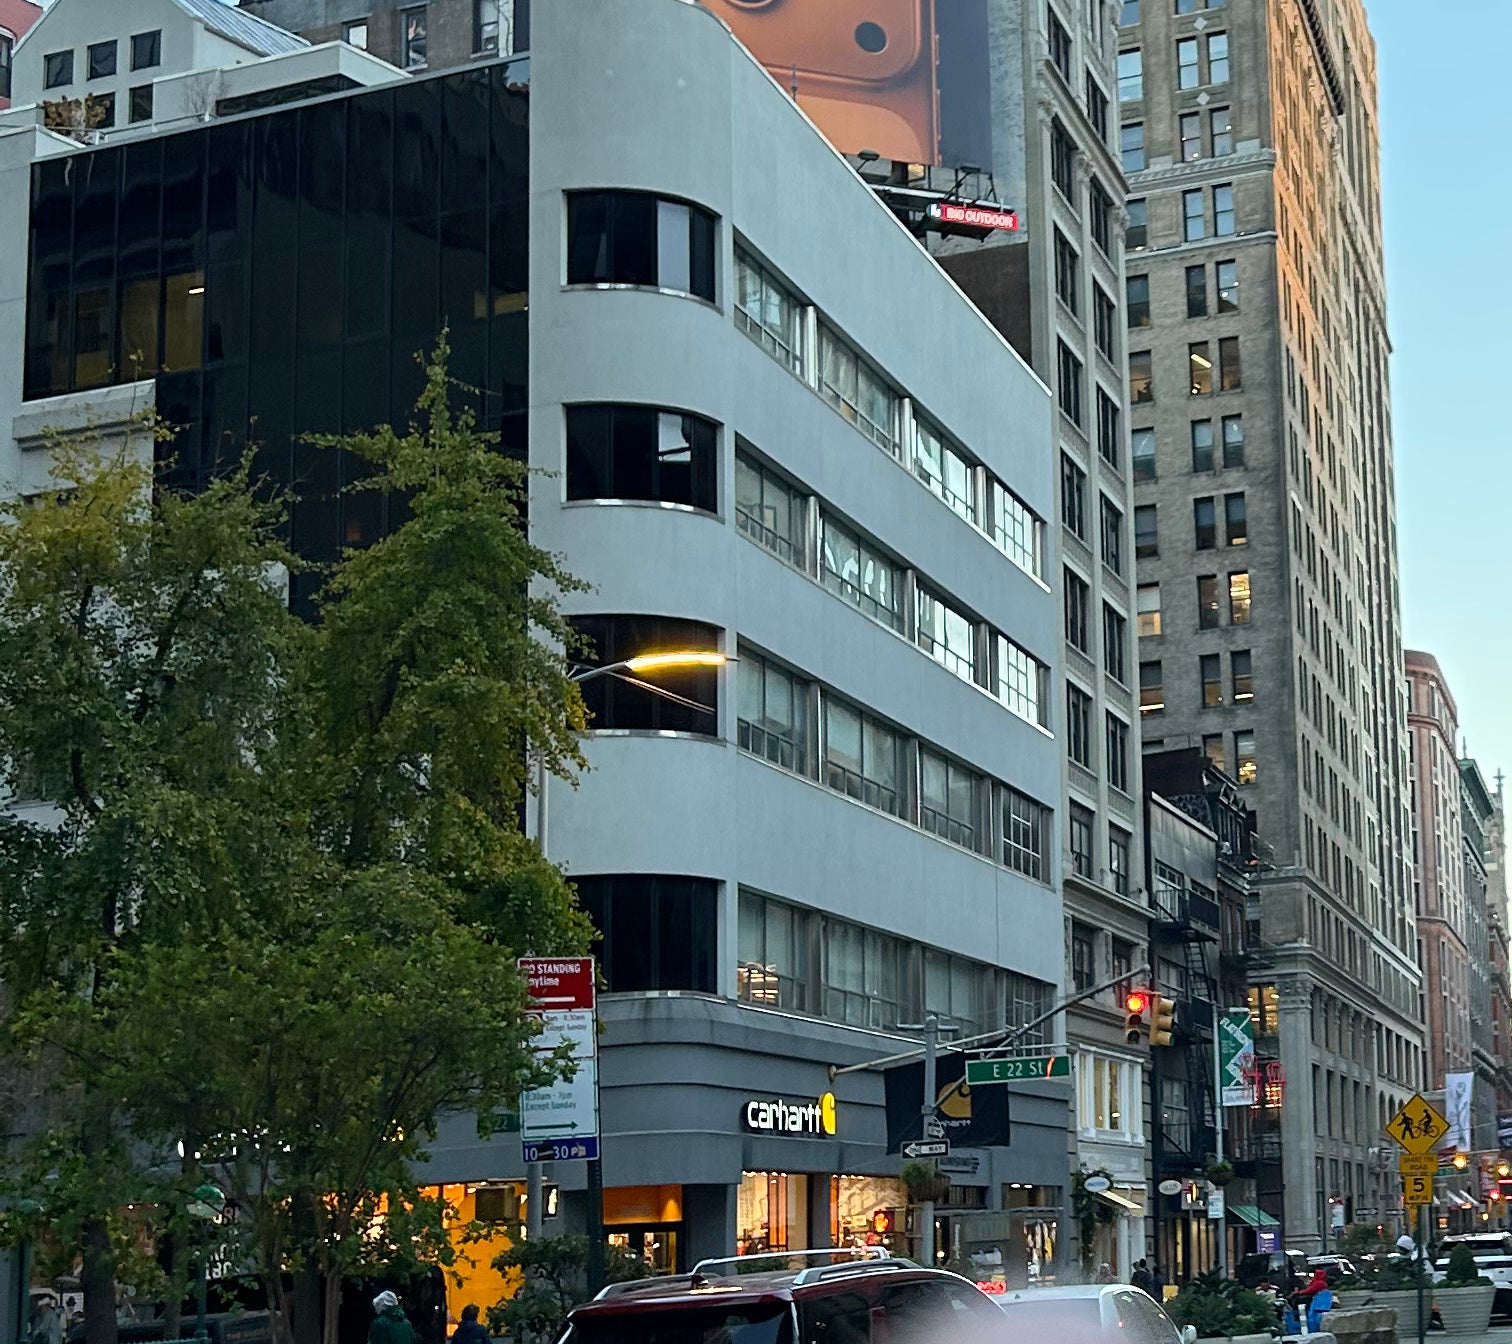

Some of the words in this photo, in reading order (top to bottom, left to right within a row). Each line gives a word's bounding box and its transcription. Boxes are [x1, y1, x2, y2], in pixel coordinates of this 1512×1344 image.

[946, 207, 965, 221] BIG
[964, 209, 1014, 228] OUTDOOR
[537, 963, 581, 975] STANDING
[993, 1065, 1000, 1078] E
[1007, 1063, 1023, 1077] 22
[1029, 1061, 1044, 1076] St
[747, 1098, 822, 1134] carhartt
[1412, 1177, 1426, 1193] 5
